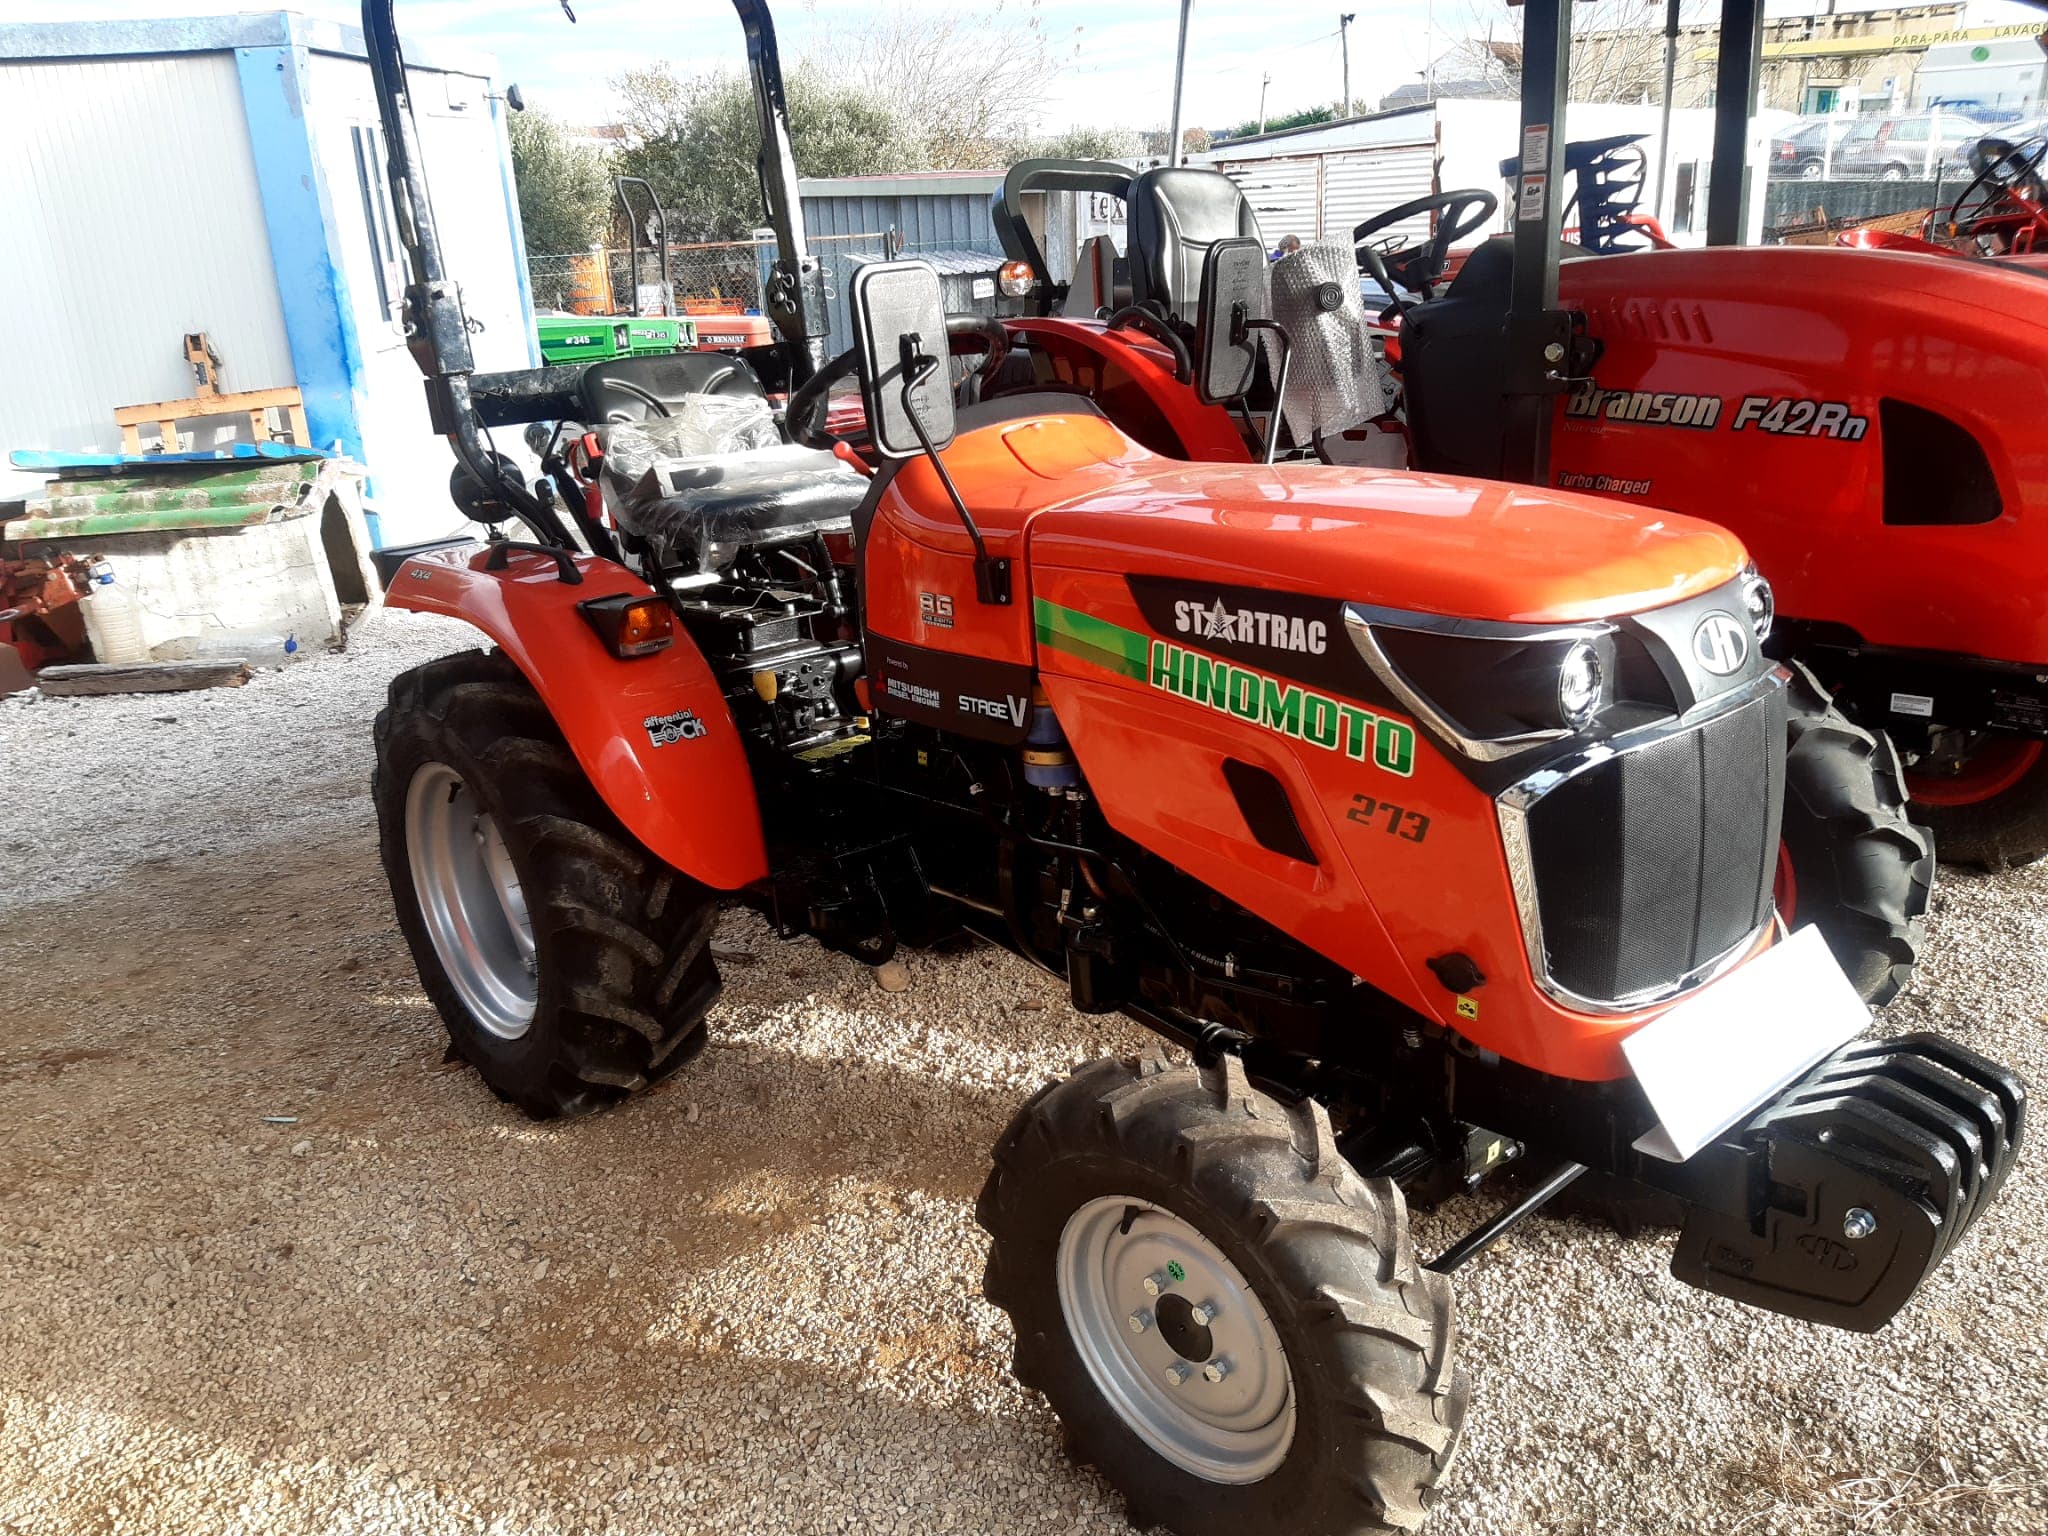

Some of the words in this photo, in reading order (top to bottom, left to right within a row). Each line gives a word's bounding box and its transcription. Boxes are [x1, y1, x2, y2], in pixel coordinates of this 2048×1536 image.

[713, 335, 745, 344] RENAULT
[1565, 382, 1721, 428] Branson
[1732, 397, 1869, 441] F42Rn
[1559, 472, 1593, 488] Turbo
[1595, 476, 1650, 494] Charged
[1174, 597, 1327, 655] STARTRAC
[887, 677, 940, 701] MITSUBISHI
[887, 687, 911, 701] DIESEL
[911, 694, 941, 709] ENGINE
[644, 708, 693, 728] differential
[959, 695, 1009, 720] STAGE
[1006, 694, 1028, 728] V
[1150, 640, 1416, 778] HINOMOTO
[1347, 793, 1431, 844] 273
